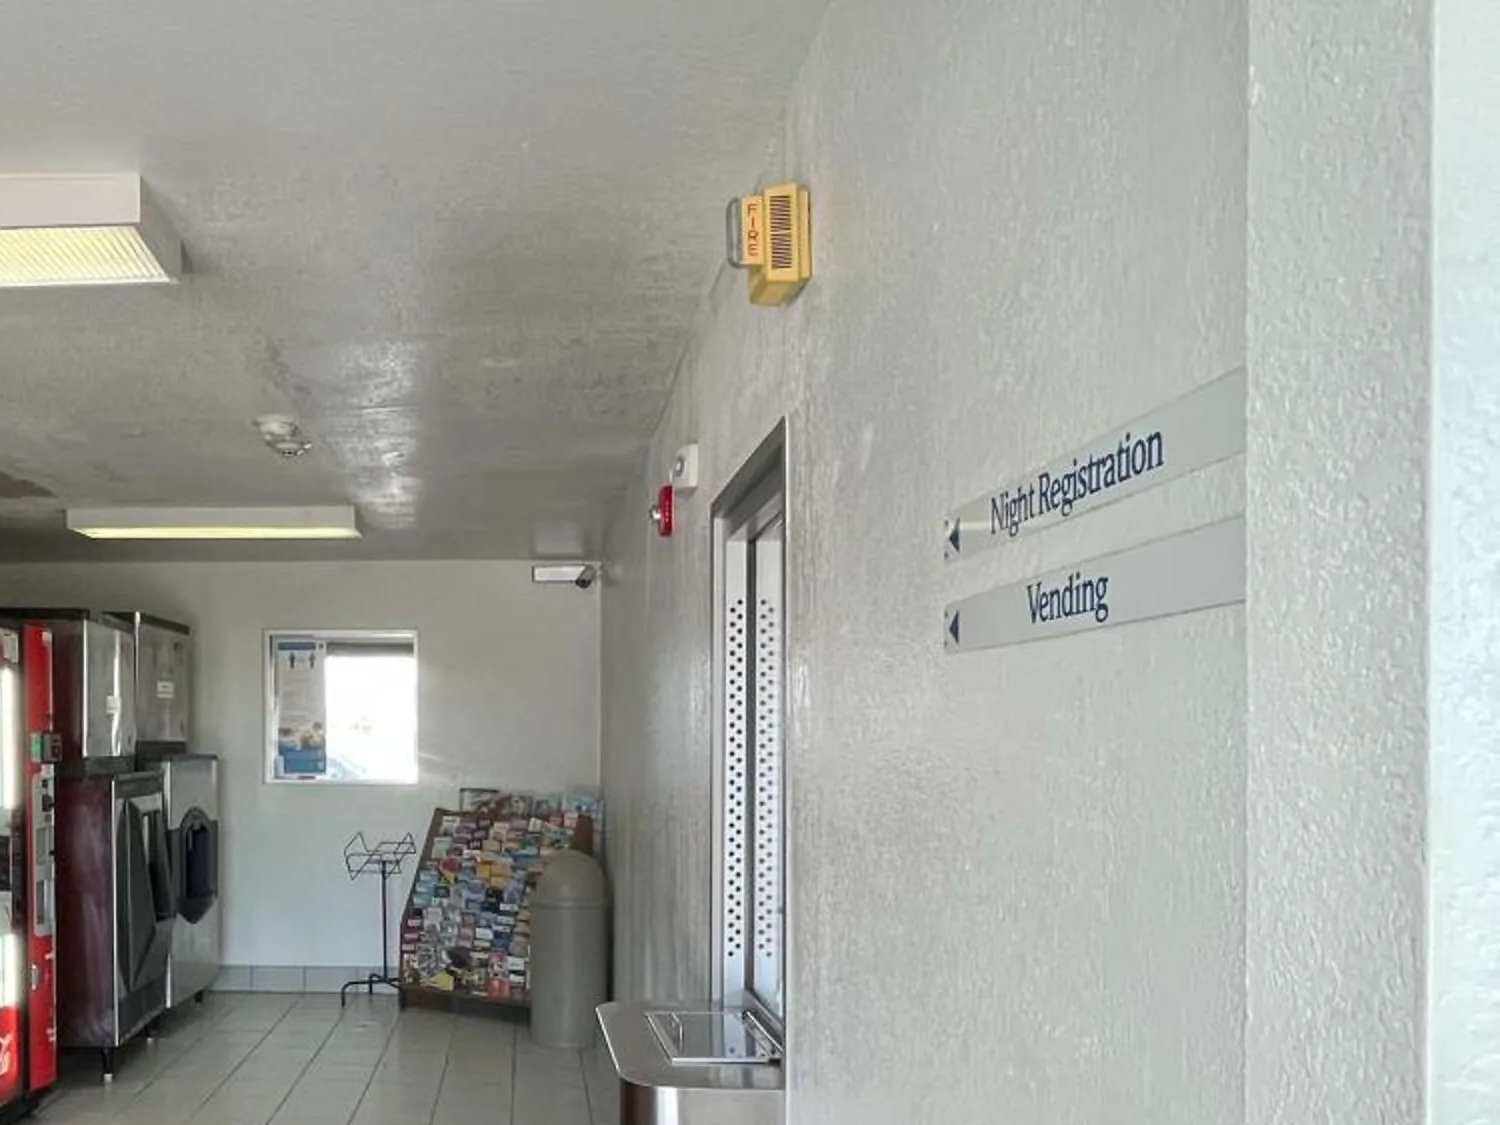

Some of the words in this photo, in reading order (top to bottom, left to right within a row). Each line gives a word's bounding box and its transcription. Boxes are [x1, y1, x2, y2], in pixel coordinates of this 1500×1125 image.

[747, 203, 759, 257] FIRE
[990, 482, 1034, 537] Night
[1038, 431, 1164, 517] Registration
[1027, 572, 1109, 624] Vending
